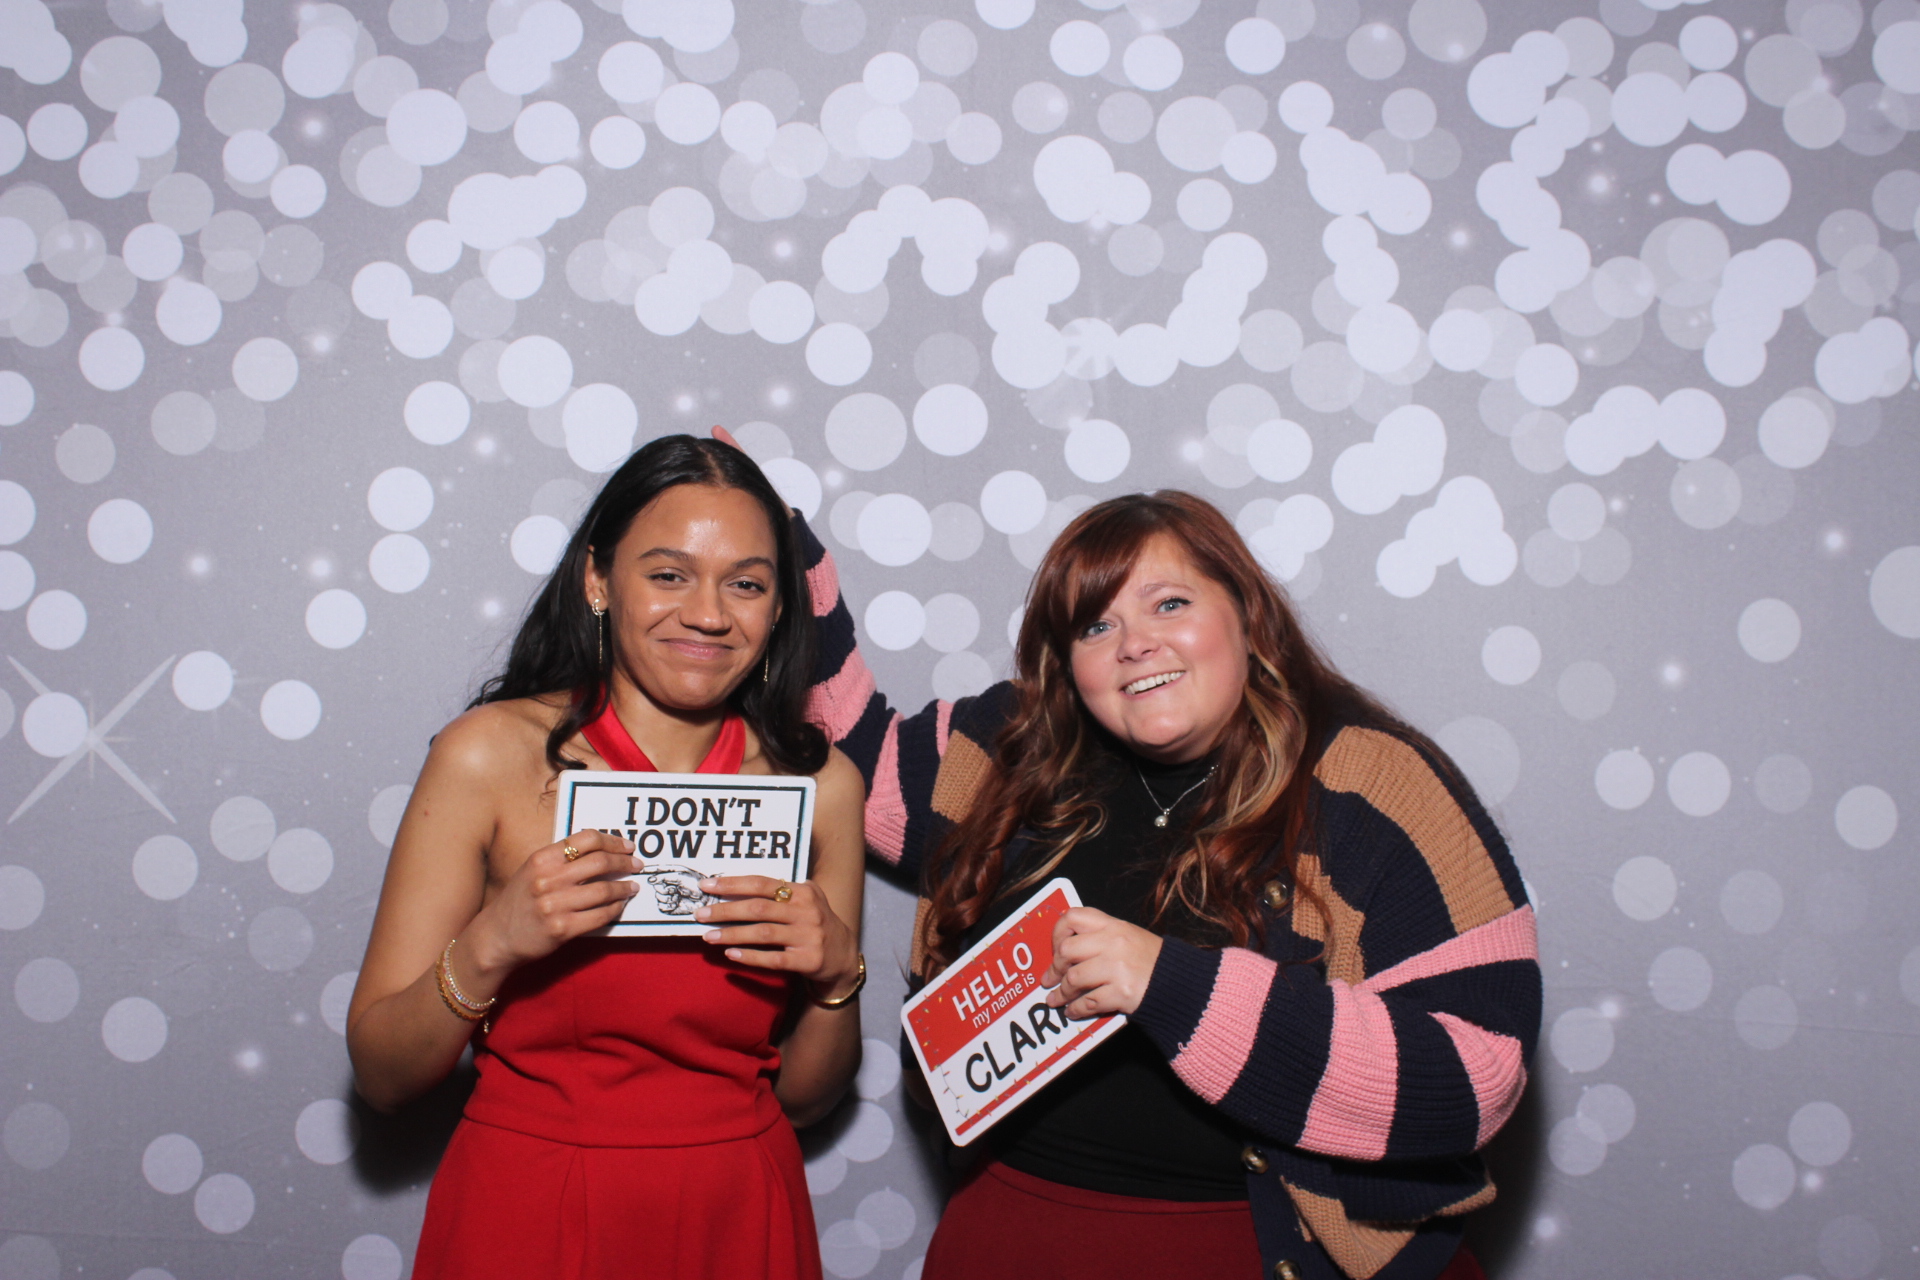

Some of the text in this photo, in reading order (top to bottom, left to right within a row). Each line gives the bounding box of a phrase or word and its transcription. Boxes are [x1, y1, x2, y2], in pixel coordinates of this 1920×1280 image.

[625, 797, 761, 827] I DON’T
[581, 829, 791, 859] OW HER
[952, 942, 1034, 1021] HELLO
[972, 971, 1036, 1029] my name is
